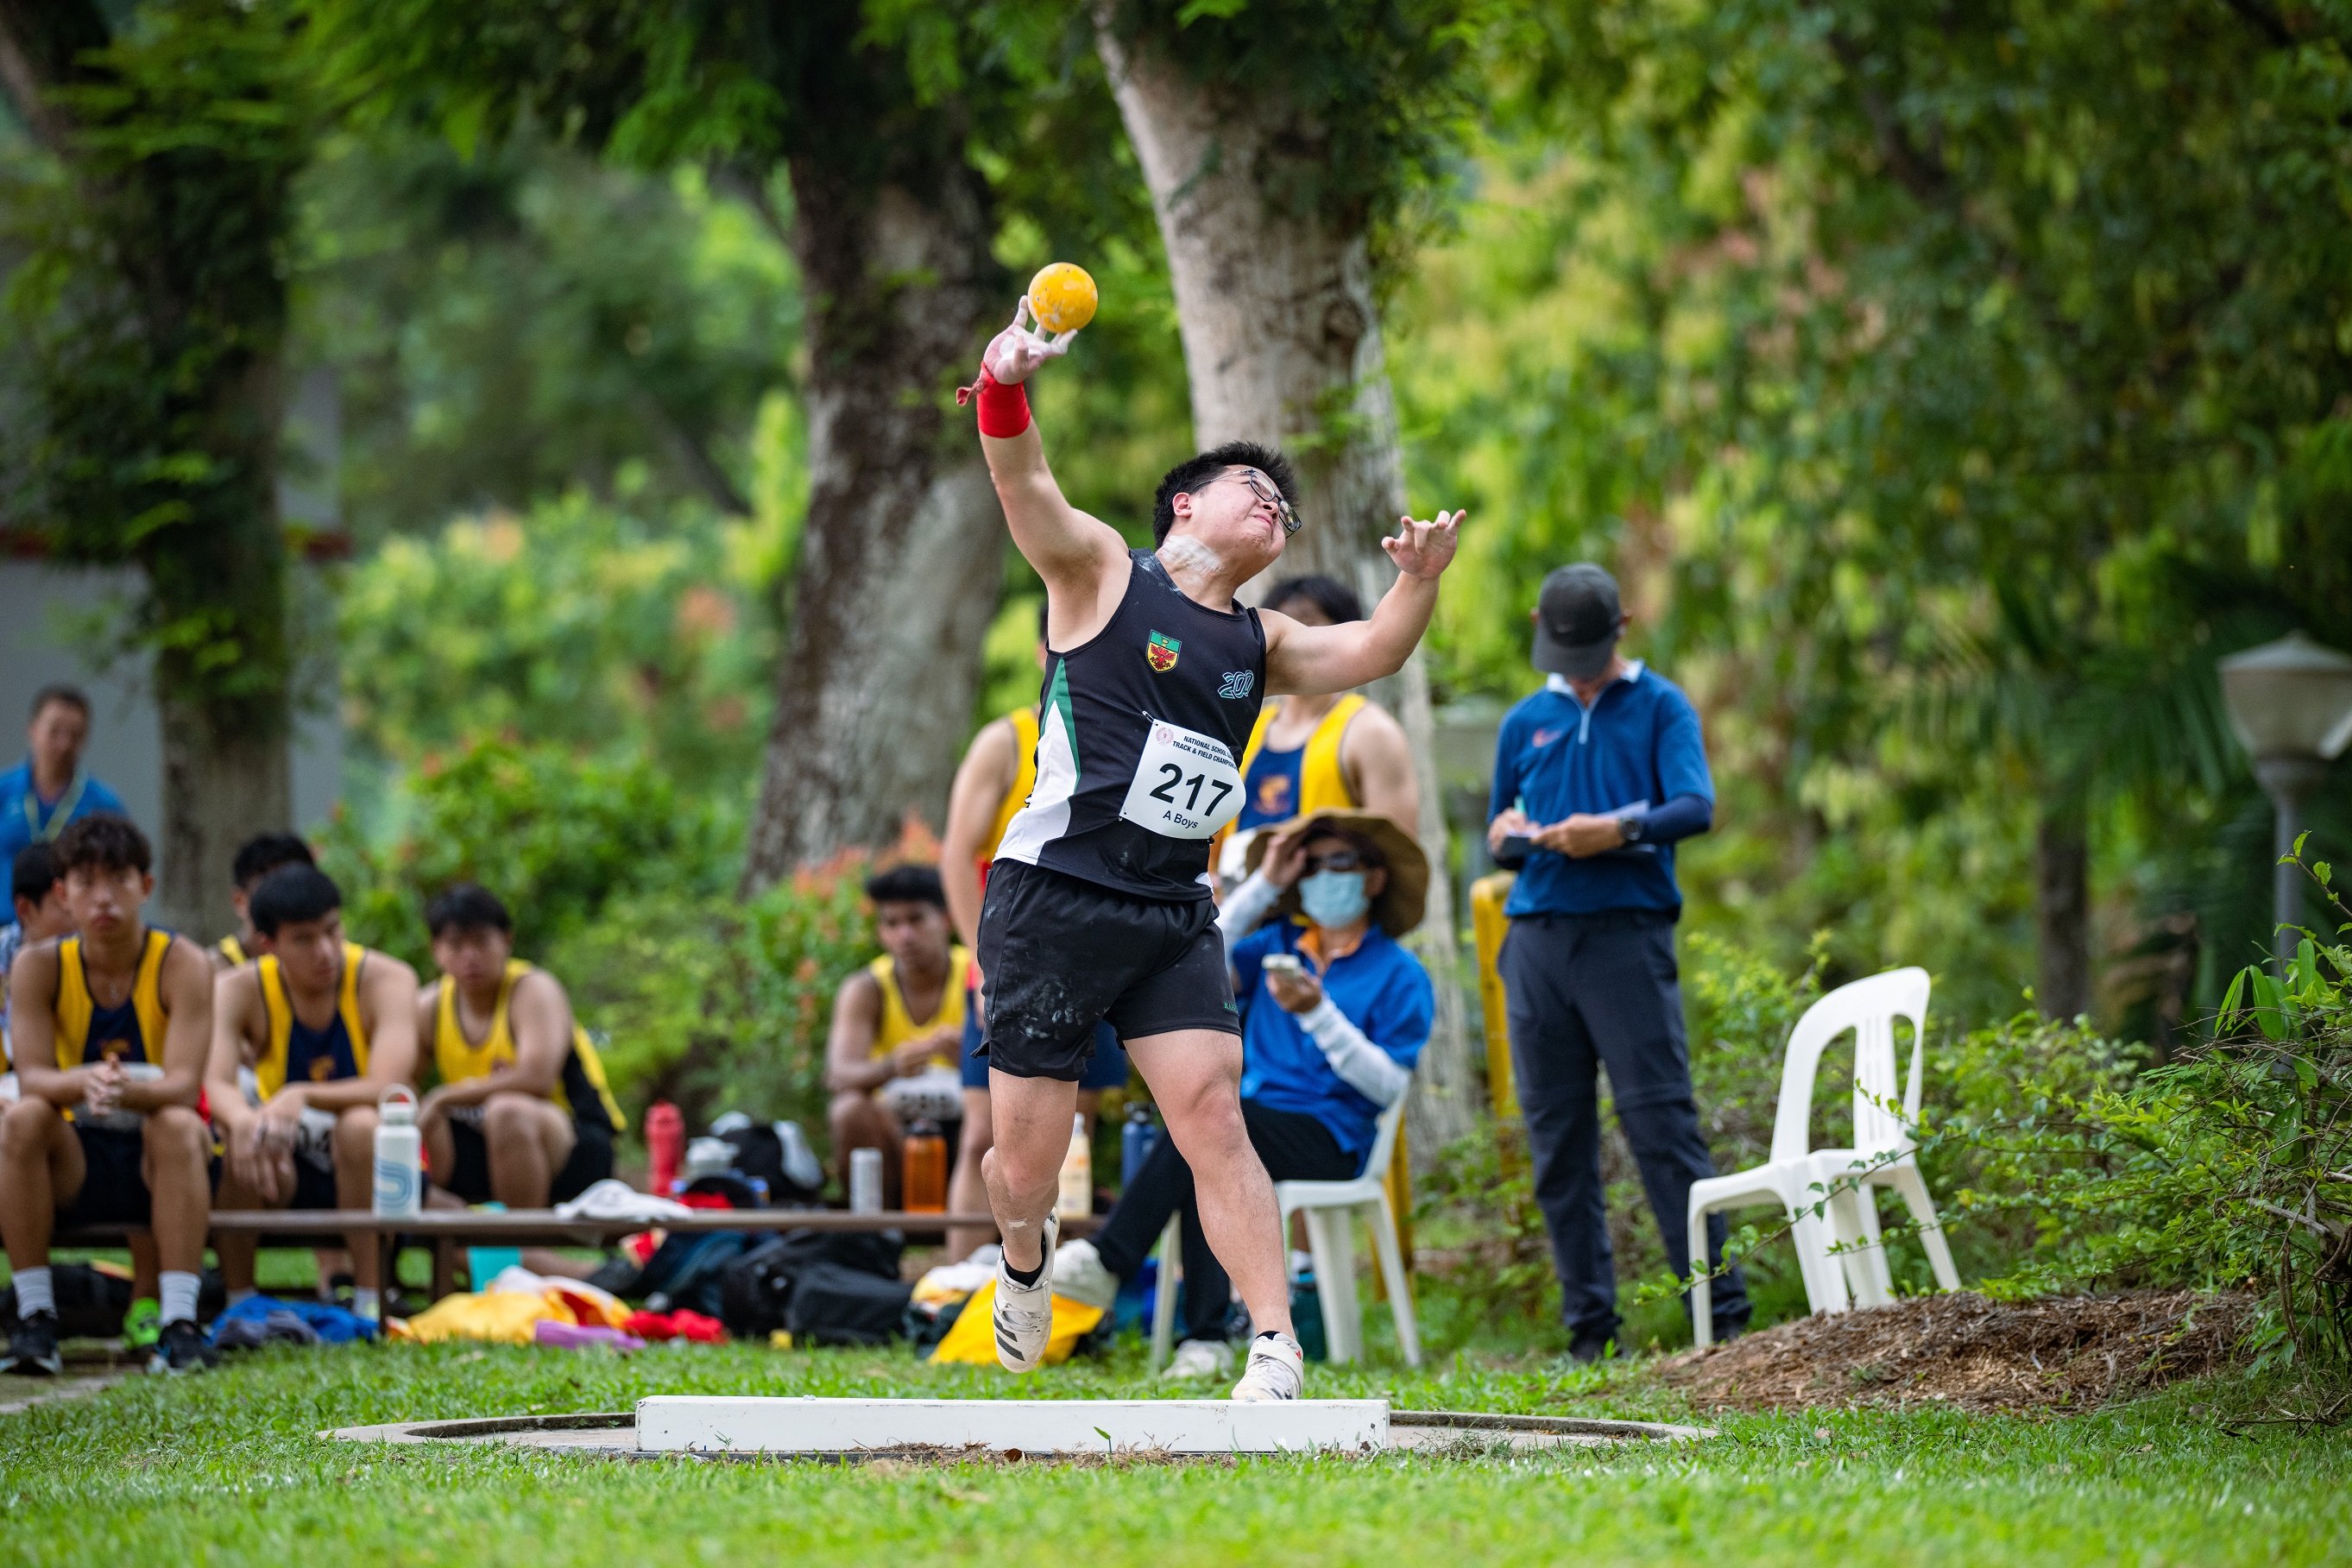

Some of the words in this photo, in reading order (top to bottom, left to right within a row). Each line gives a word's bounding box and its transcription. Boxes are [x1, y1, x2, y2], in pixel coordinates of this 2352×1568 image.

[1172, 740, 1191, 753] TRACK
[1197, 749, 1213, 760] FIELD
[1183, 735, 1210, 751] NATIONAL
[1211, 745, 1227, 757] SCHOOL
[1150, 763, 1233, 817] 217
[1163, 809, 1172, 821] A
[1173, 813, 1199, 829] Boys
